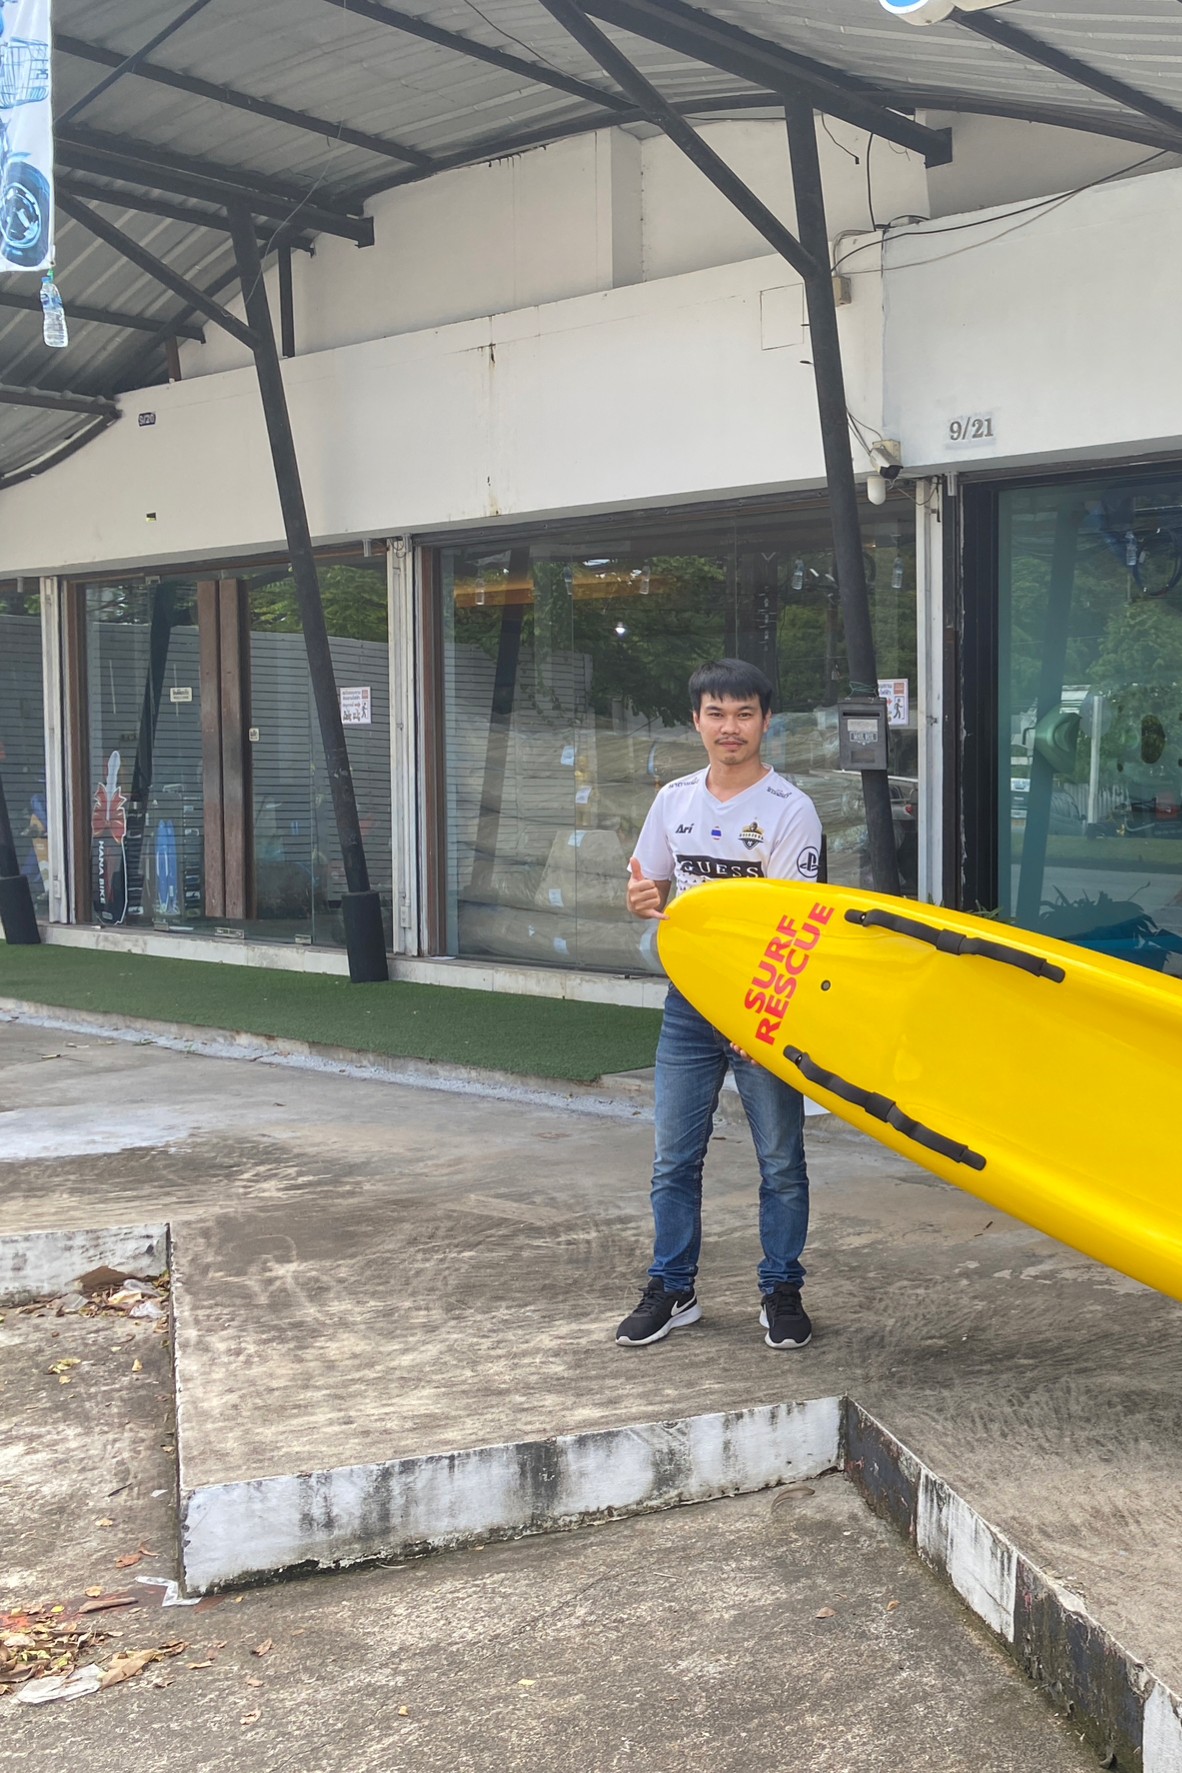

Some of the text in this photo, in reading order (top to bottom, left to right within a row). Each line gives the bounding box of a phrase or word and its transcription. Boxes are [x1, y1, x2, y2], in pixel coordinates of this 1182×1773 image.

[950, 417, 994, 441] 9/21
[675, 823, 695, 834] Ari
[680, 860, 759, 878] GUESS
[744, 914, 798, 1015] SURF
[755, 902, 835, 1046] RESCUE
